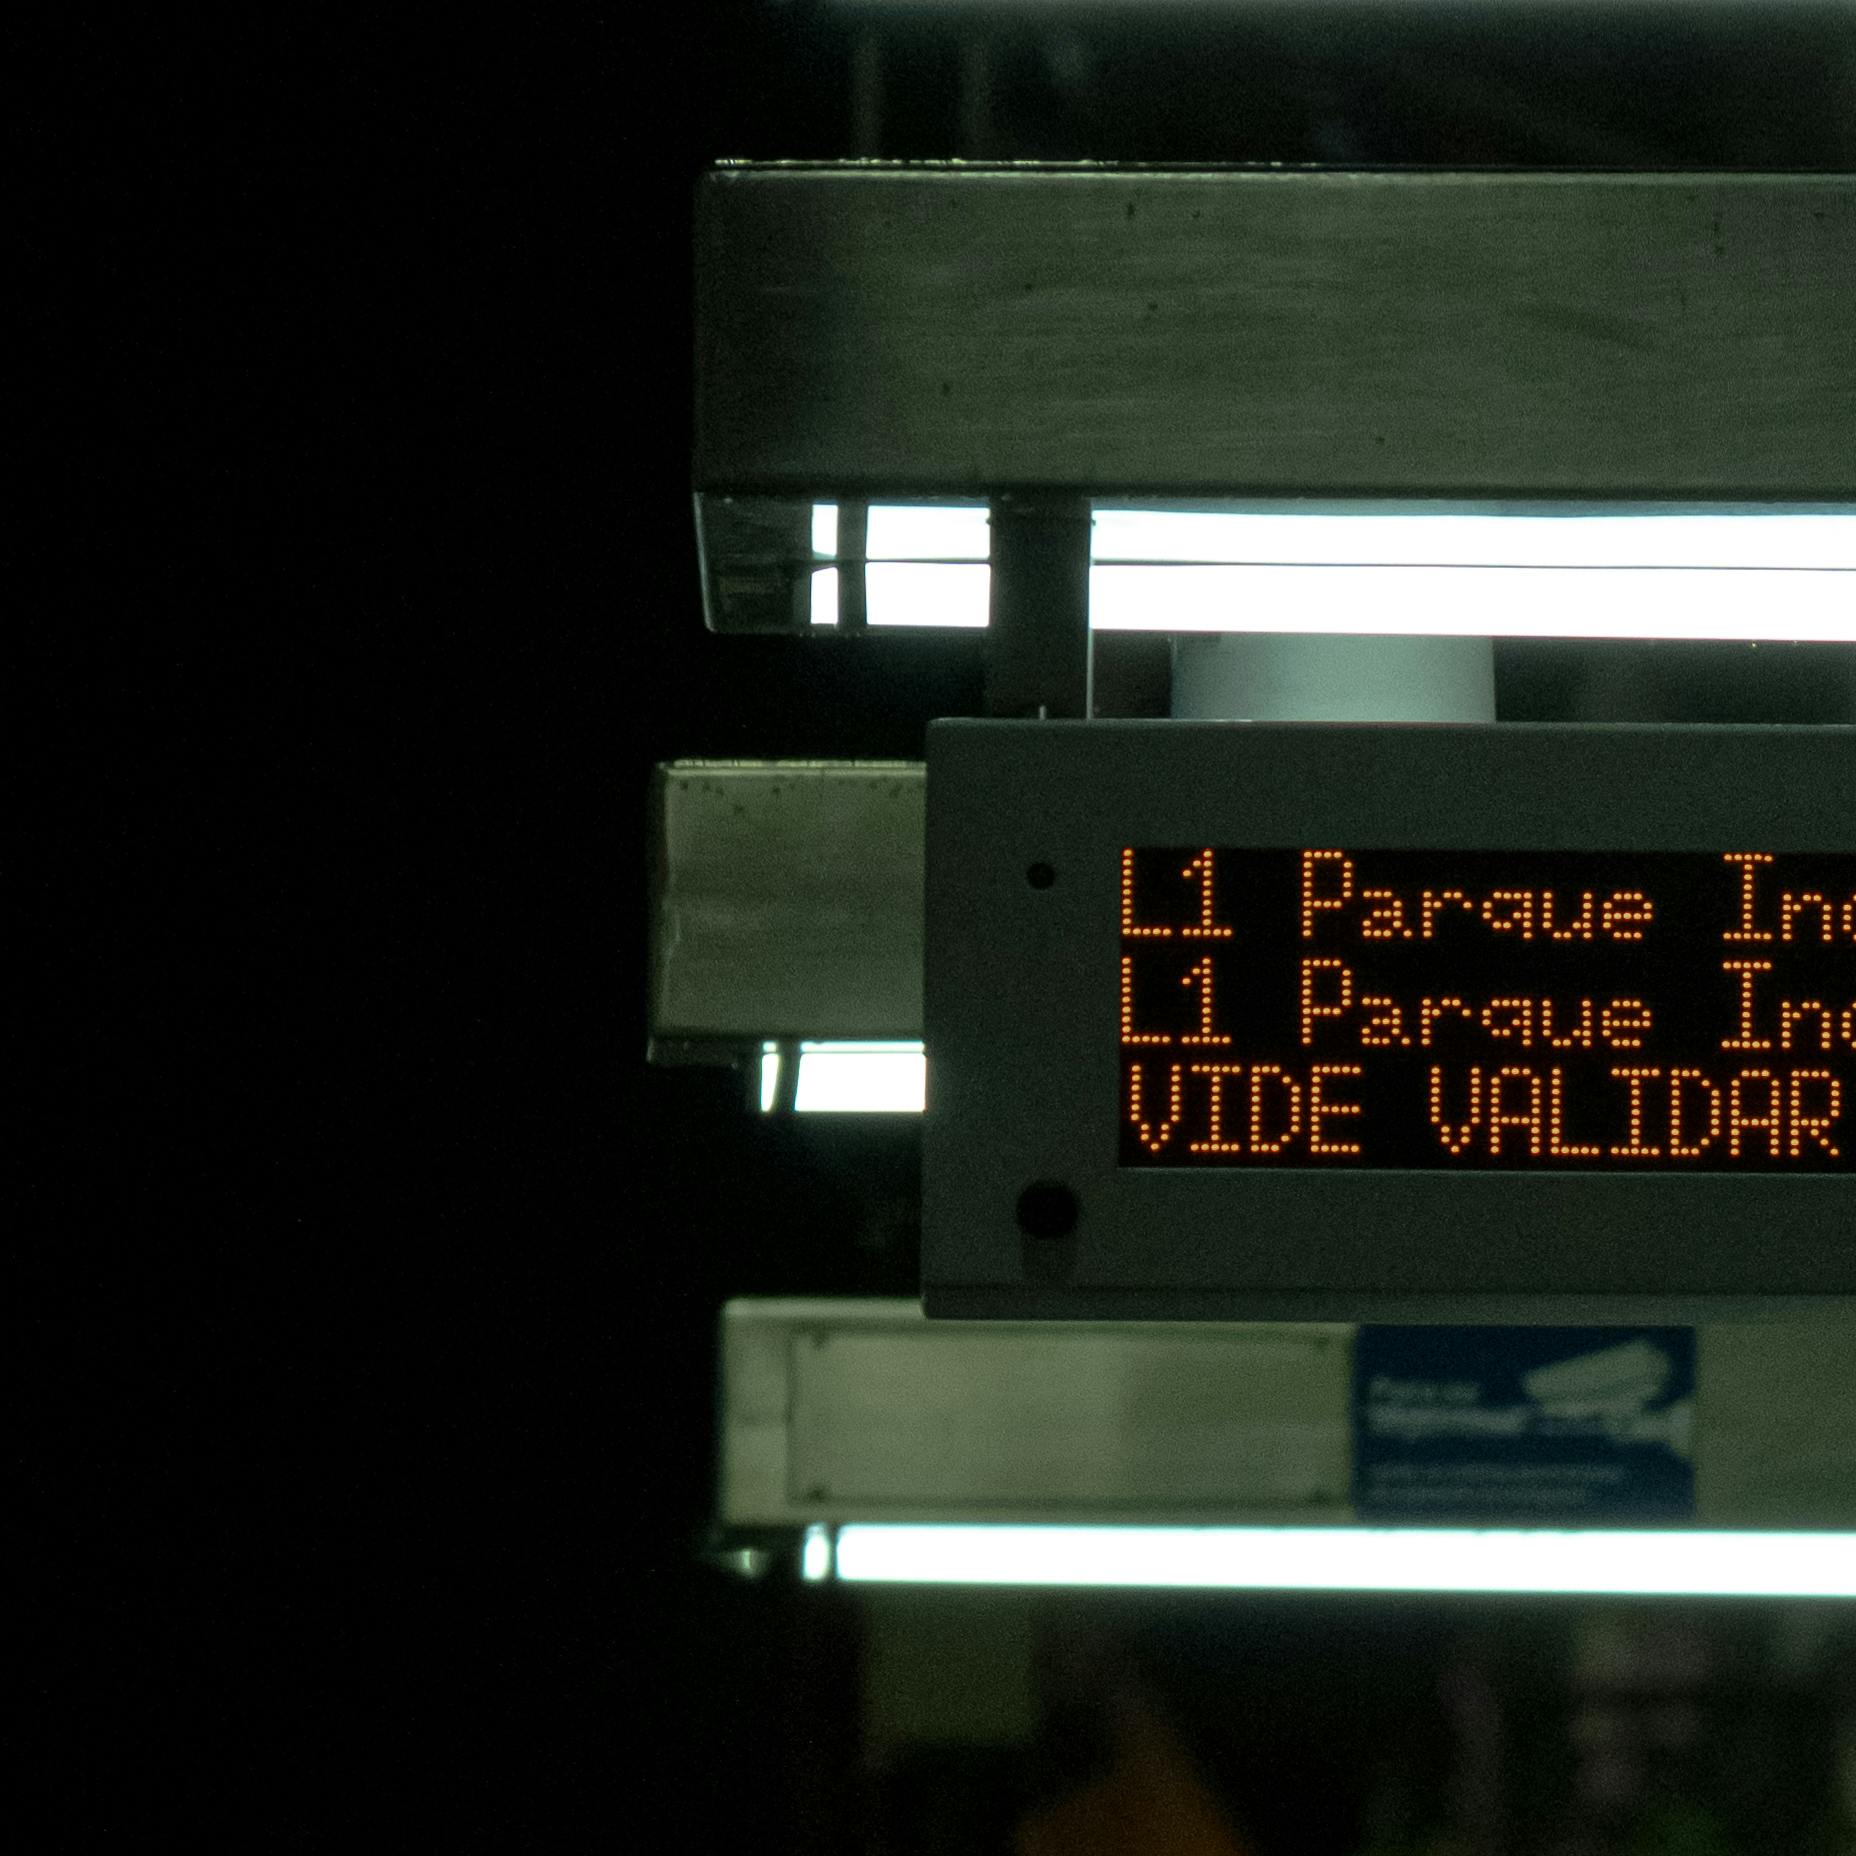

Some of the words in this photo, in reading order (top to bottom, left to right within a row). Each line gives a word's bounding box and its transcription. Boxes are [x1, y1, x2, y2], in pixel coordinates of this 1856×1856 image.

[1121, 847, 1233, 937] L1
[1301, 849, 1653, 940] Parque
[1121, 956, 1232, 1045] L1
[1301, 958, 1652, 1048] Parque
[1129, 1063, 1362, 1154] VIDE
[1429, 1065, 1841, 1157] VALIDAR
